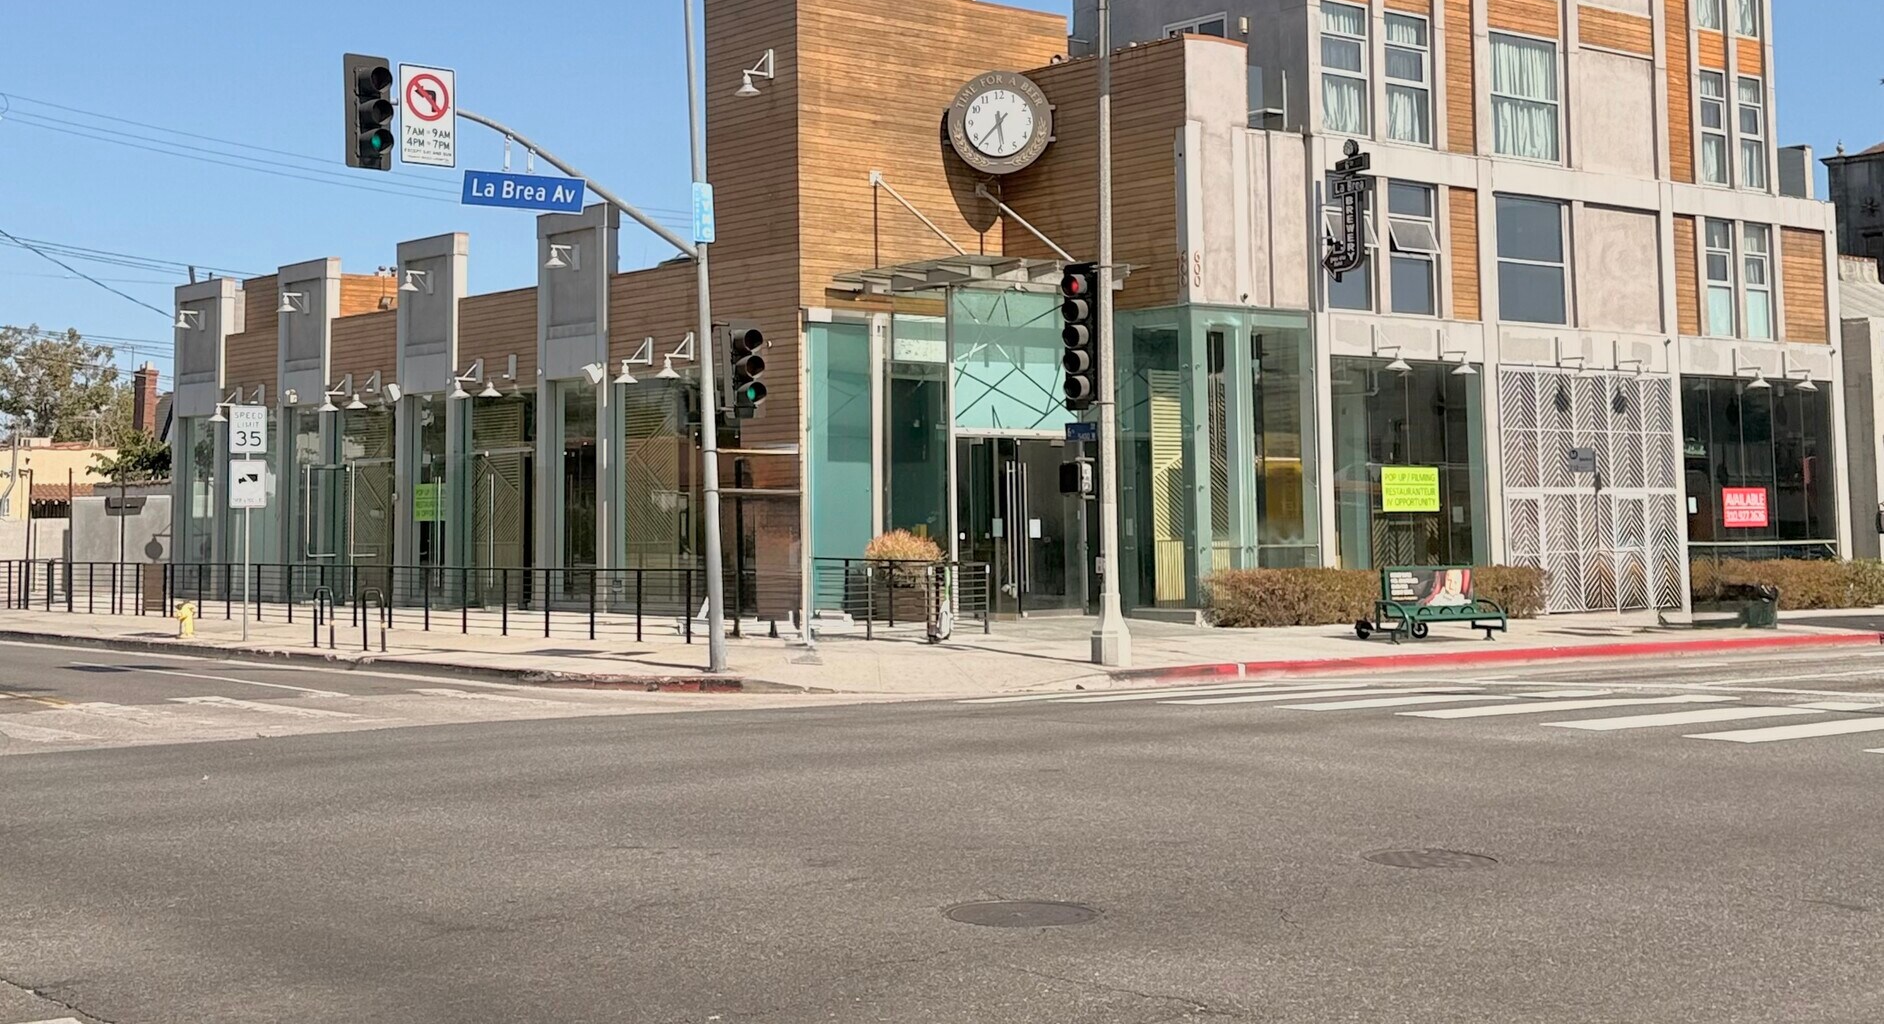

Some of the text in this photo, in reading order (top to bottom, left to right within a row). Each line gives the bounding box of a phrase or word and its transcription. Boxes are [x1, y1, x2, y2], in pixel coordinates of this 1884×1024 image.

[955, 75, 1043, 110] TIME FOR A BEER
[994, 90, 1005, 100] 12
[981, 95, 989, 104] 11
[1011, 94, 1016, 103] 1
[972, 105, 981, 114] 10
[1021, 103, 1028, 112] 2
[968, 119, 974, 127] 9
[1026, 117, 1032, 126] 3
[405, 125, 425, 136] 7AM
[431, 128, 451, 140] 9AM
[973, 133, 979, 141] 8
[1022, 131, 1028, 140] 4
[406, 137, 425, 147] 4PM
[432, 139, 450, 150] 7PM
[984, 142, 989, 150] 7
[1012, 141, 1018, 150] 5
[997, 144, 1003, 154] 6
[471, 177, 576, 204] La Brea Av
[1345, 196, 1355, 262] BREWERY
[1193, 249, 1201, 288] 600
[234, 412, 264, 420] SPEED
[235, 430, 262, 447] 35
[1385, 473, 1396, 481] POP
[1398, 473, 1406, 481] UP
[1411, 473, 1436, 482] FILMING
[1395, 497, 1436, 506] OPPORTUNITY
[1726, 493, 1765, 506] AVAILABLE
